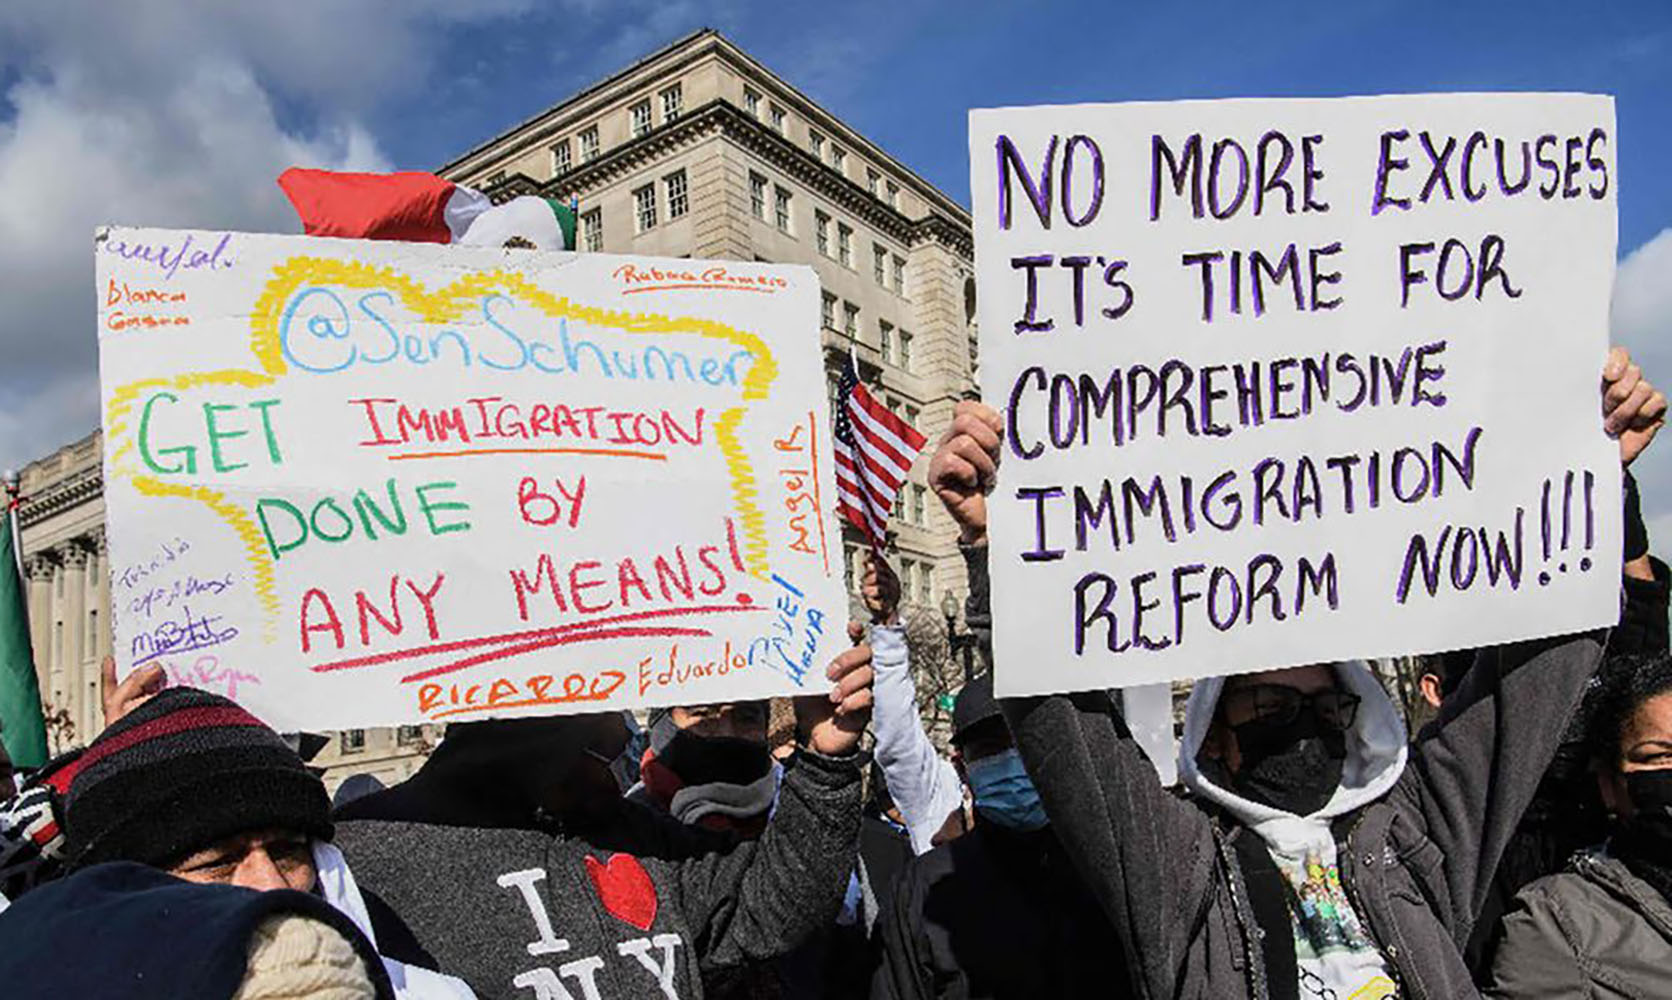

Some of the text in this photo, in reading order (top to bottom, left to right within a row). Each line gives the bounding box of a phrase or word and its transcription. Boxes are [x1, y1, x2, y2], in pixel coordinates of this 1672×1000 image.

[996, 127, 1608, 230] NO MORE EXCUSES
[1010, 234, 1522, 335] IT'S TIME FOR
[279, 286, 752, 387] @SenSchumer
[137, 391, 705, 474] GET IMMIGRATION
[1006, 340, 1447, 460] COMPREHENSIVE
[256, 474, 586, 560] DONE BY
[1015, 427, 1484, 562] IMMIGRATION
[299, 573, 446, 654] ANY
[510, 516, 754, 622] MEANS!
[1074, 470, 1596, 656] REFORM NOW!!!
[638, 640, 748, 698] Eduardo
[496, 867, 571, 957] I
